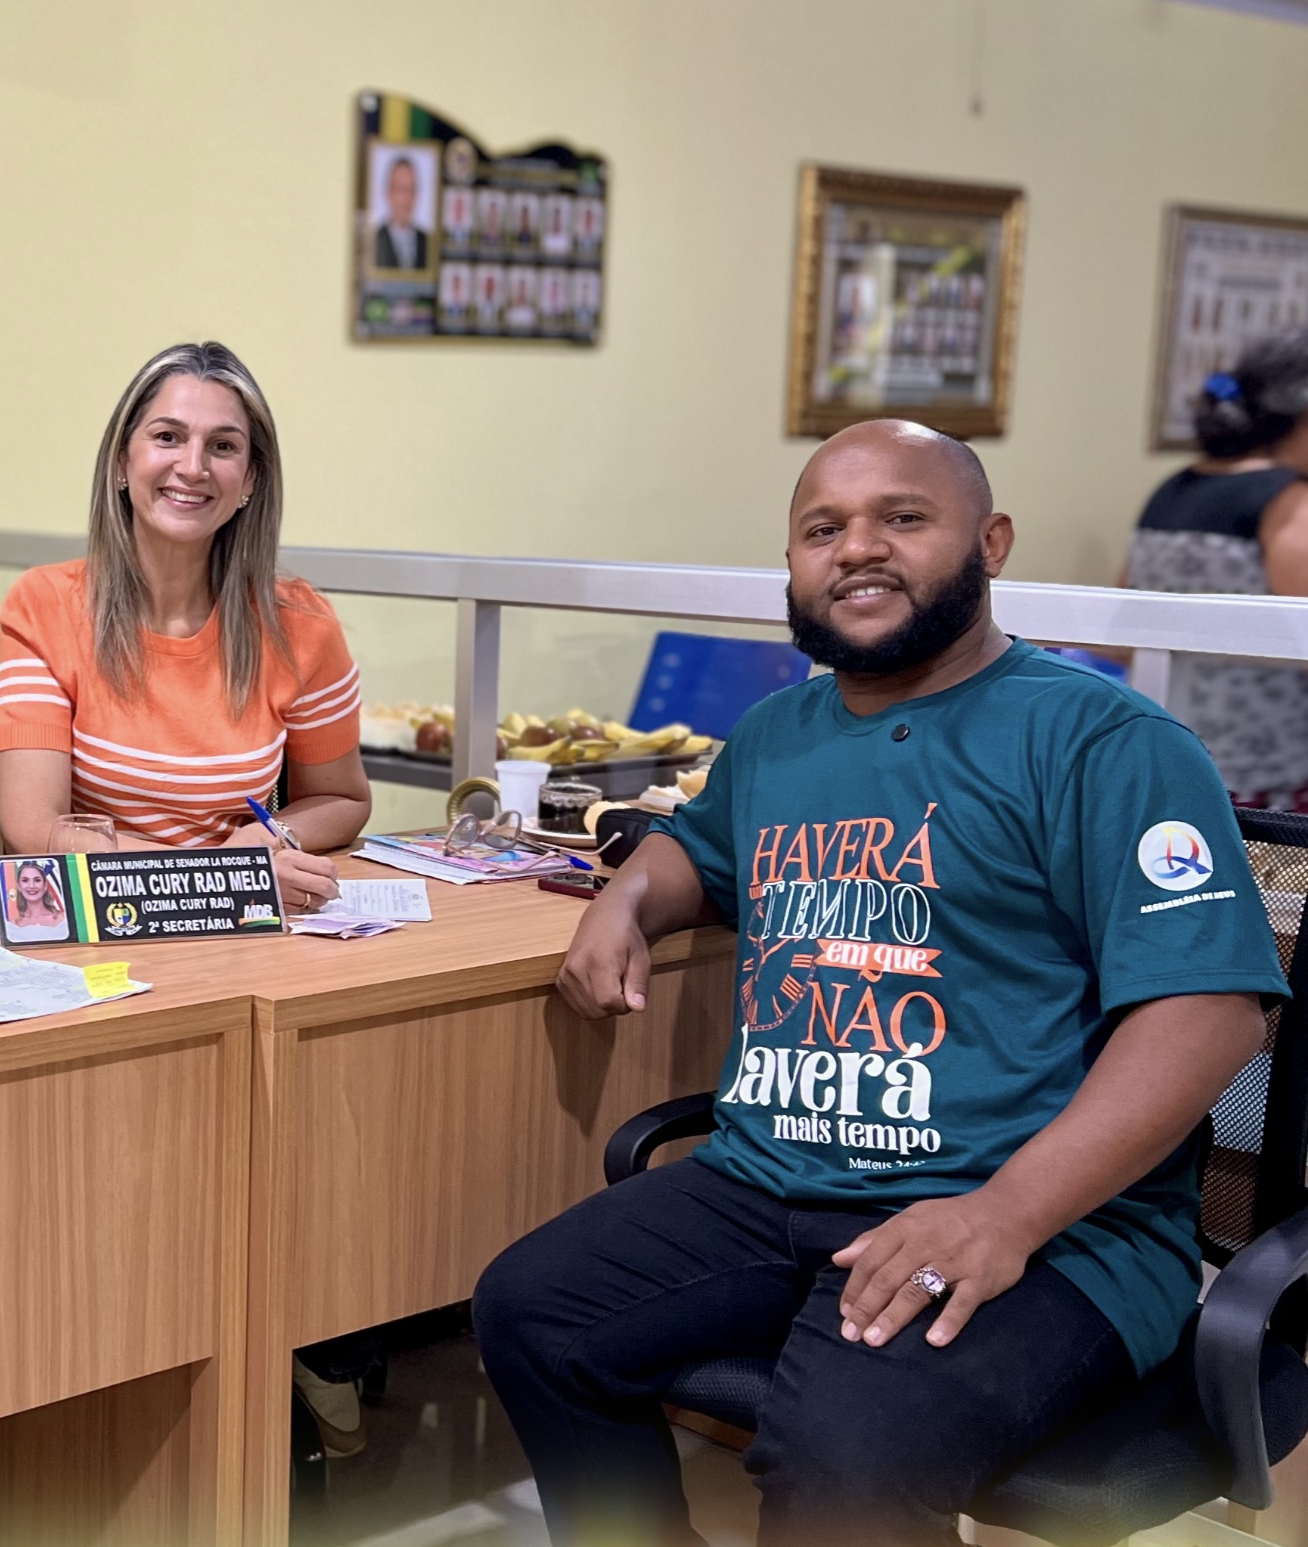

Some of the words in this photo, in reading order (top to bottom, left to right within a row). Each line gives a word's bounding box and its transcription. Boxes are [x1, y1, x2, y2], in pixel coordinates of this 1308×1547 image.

[750, 803, 940, 888] HAVERÁ
[91, 860, 123, 871] CÂMARA
[123, 859, 164, 870] MUNICIPAL
[164, 858, 175, 868] DE
[175, 857, 210, 868] SENADOR
[210, 857, 221, 866] LA
[221, 856, 252, 866] ROCQUE
[255, 855, 268, 864] MA
[95, 875, 147, 897] OZIMA
[149, 873, 190, 895] CURY
[193, 871, 226, 893] RAD
[228, 870, 271, 891] MELO
[141, 900, 178, 915] (OZIMA
[179, 898, 207, 910] CURY
[209, 896, 235, 911] RAD)
[244, 904, 274, 919] MDB
[762, 878, 931, 945] TEMPO
[162, 915, 235, 932] SECRETÁRIA
[825, 942, 869, 966] em
[873, 945, 928, 973] que
[773, 1111, 832, 1144] mais
[837, 1116, 941, 1156] tempo
[848, 1157, 893, 1170] Mateus
